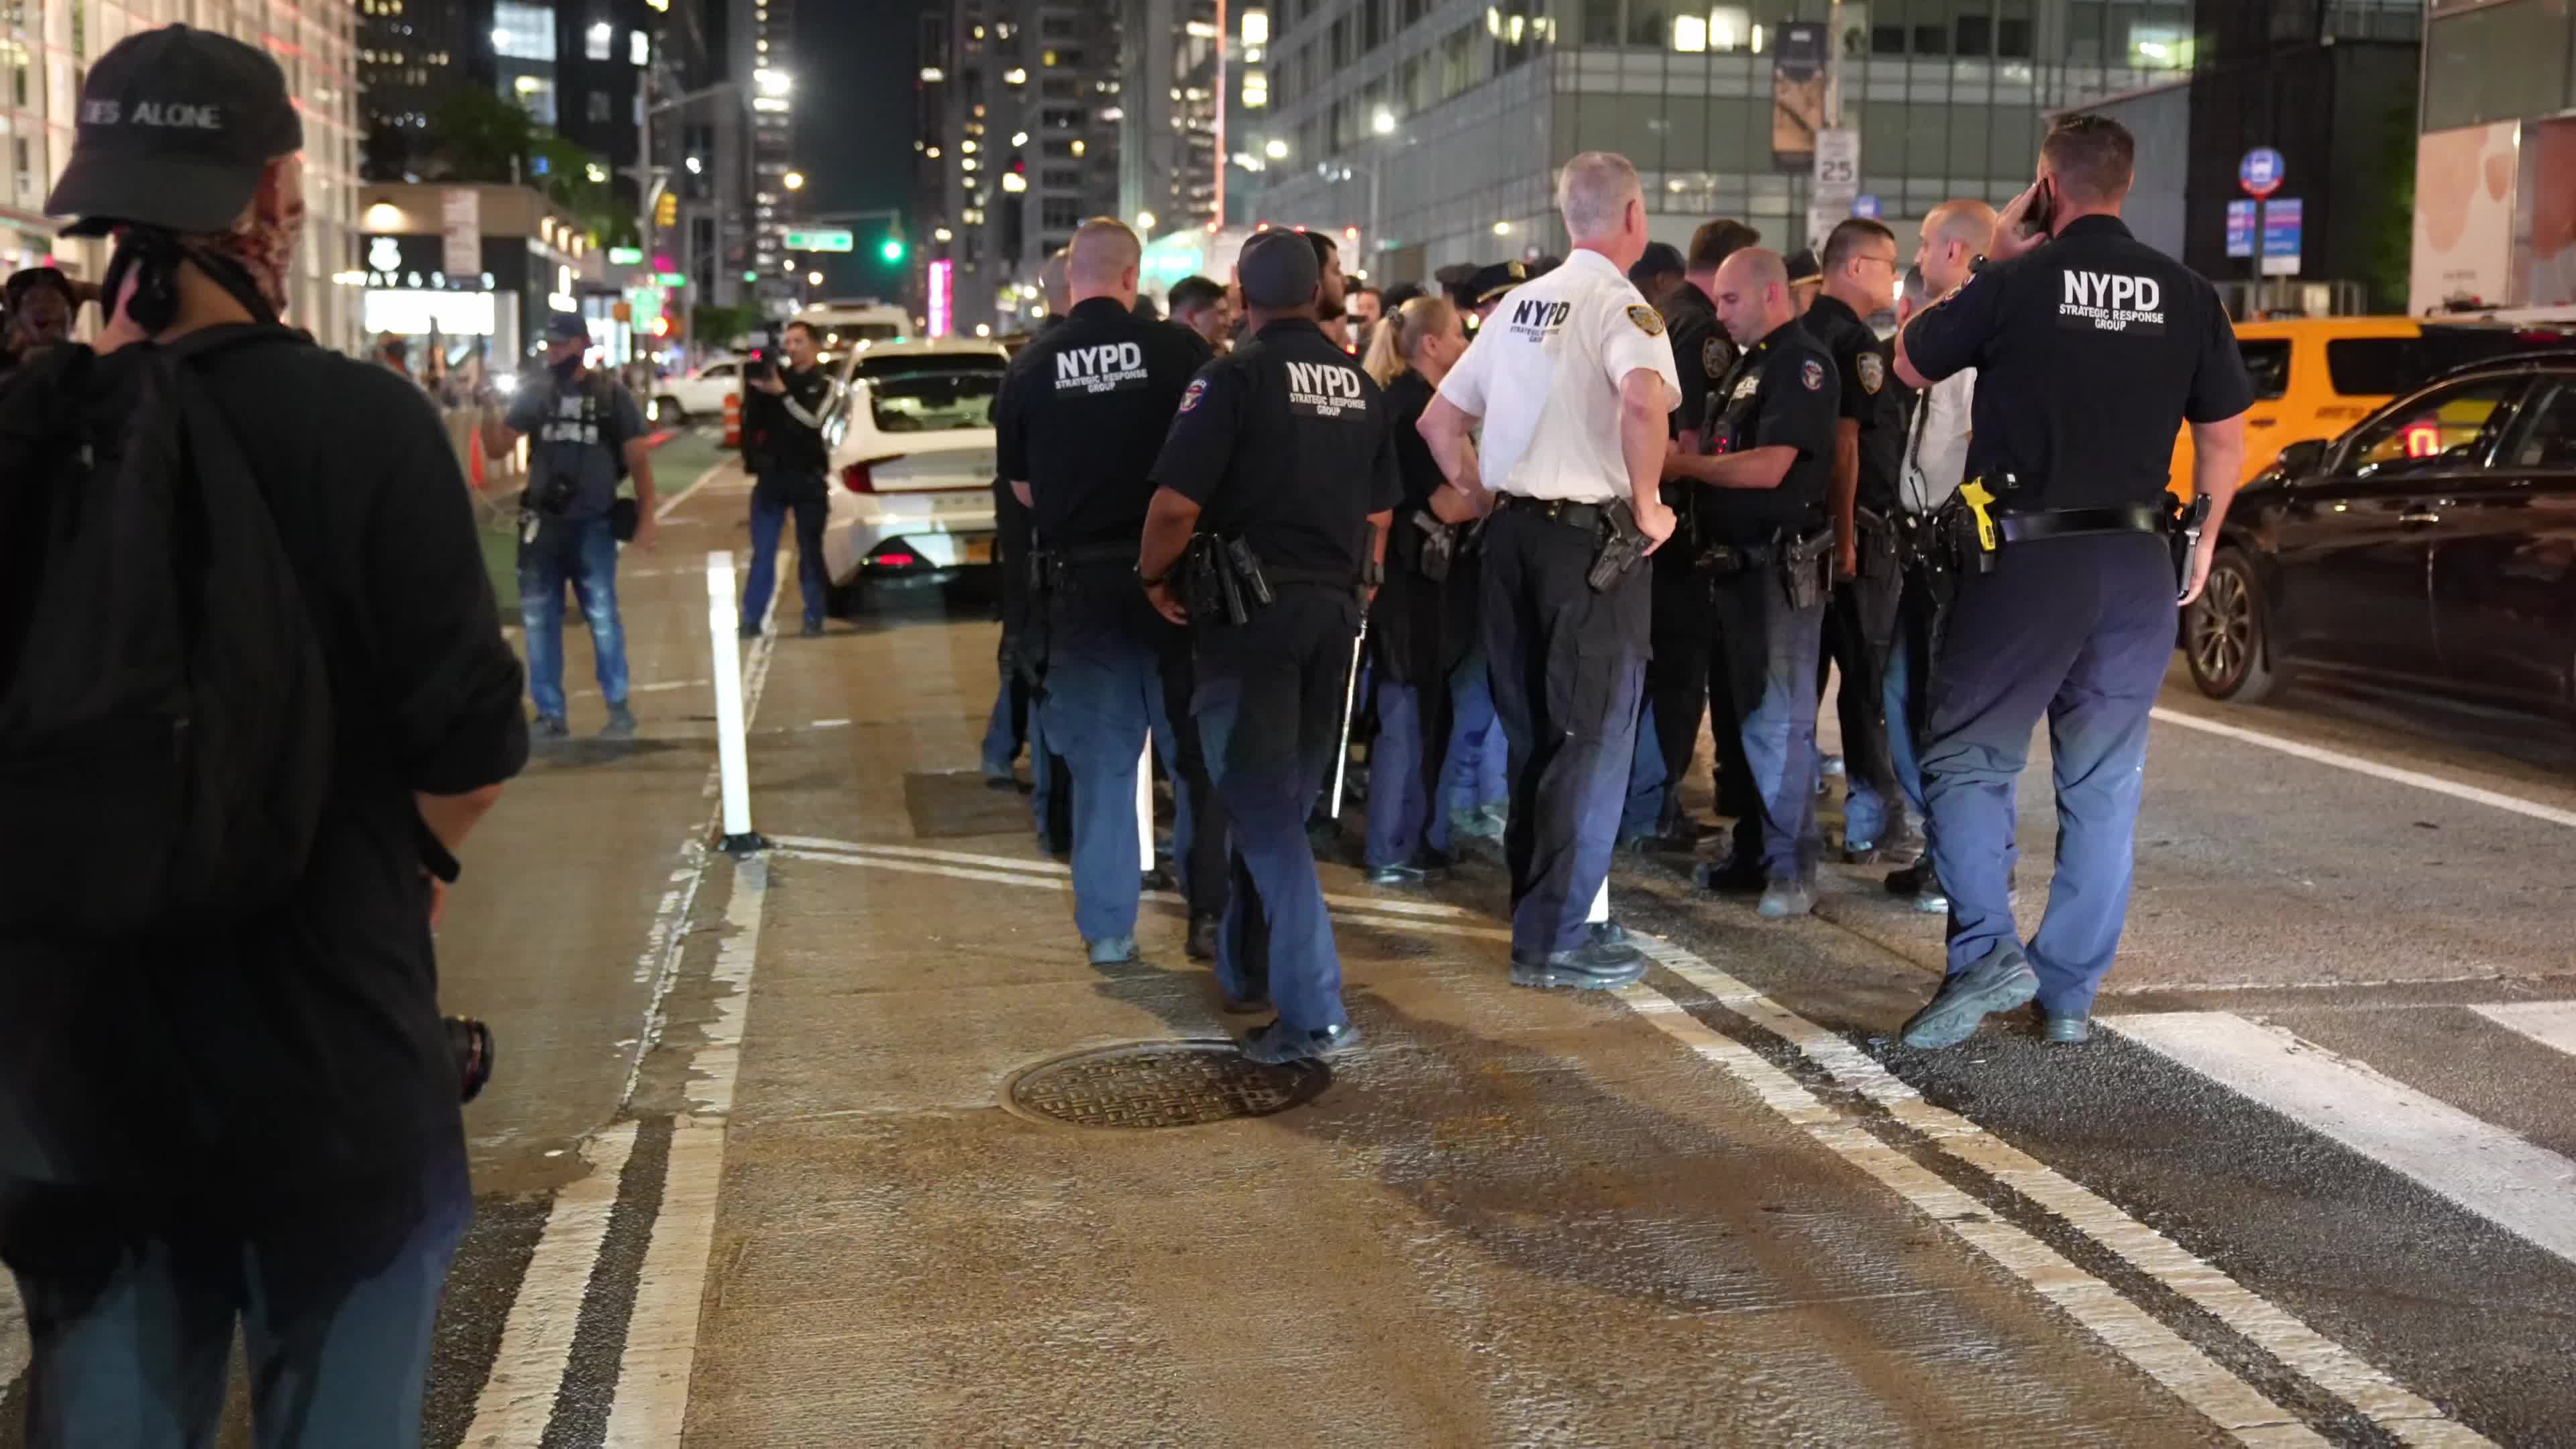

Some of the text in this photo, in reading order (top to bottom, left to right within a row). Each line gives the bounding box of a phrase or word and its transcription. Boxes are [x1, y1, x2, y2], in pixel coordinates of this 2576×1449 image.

[131, 101, 222, 129] ALONE
[1821, 160, 1852, 181] 25
[2063, 270, 2159, 311] NYPD
[1512, 300, 1570, 327] NYPD
[2059, 304, 2163, 323] STRATEGIC RESPONSE
[2095, 319, 2127, 331] GROUP
[1057, 341, 1142, 380] NYPD
[1055, 369, 1148, 389] STRATEGIC RESPONSE
[1087, 382, 1116, 393] GROUP
[1286, 362, 1360, 398] NYPD
[1290, 392, 1366, 410] STRATEGIC RESPONSE
[1317, 405, 1340, 416] GROUP
